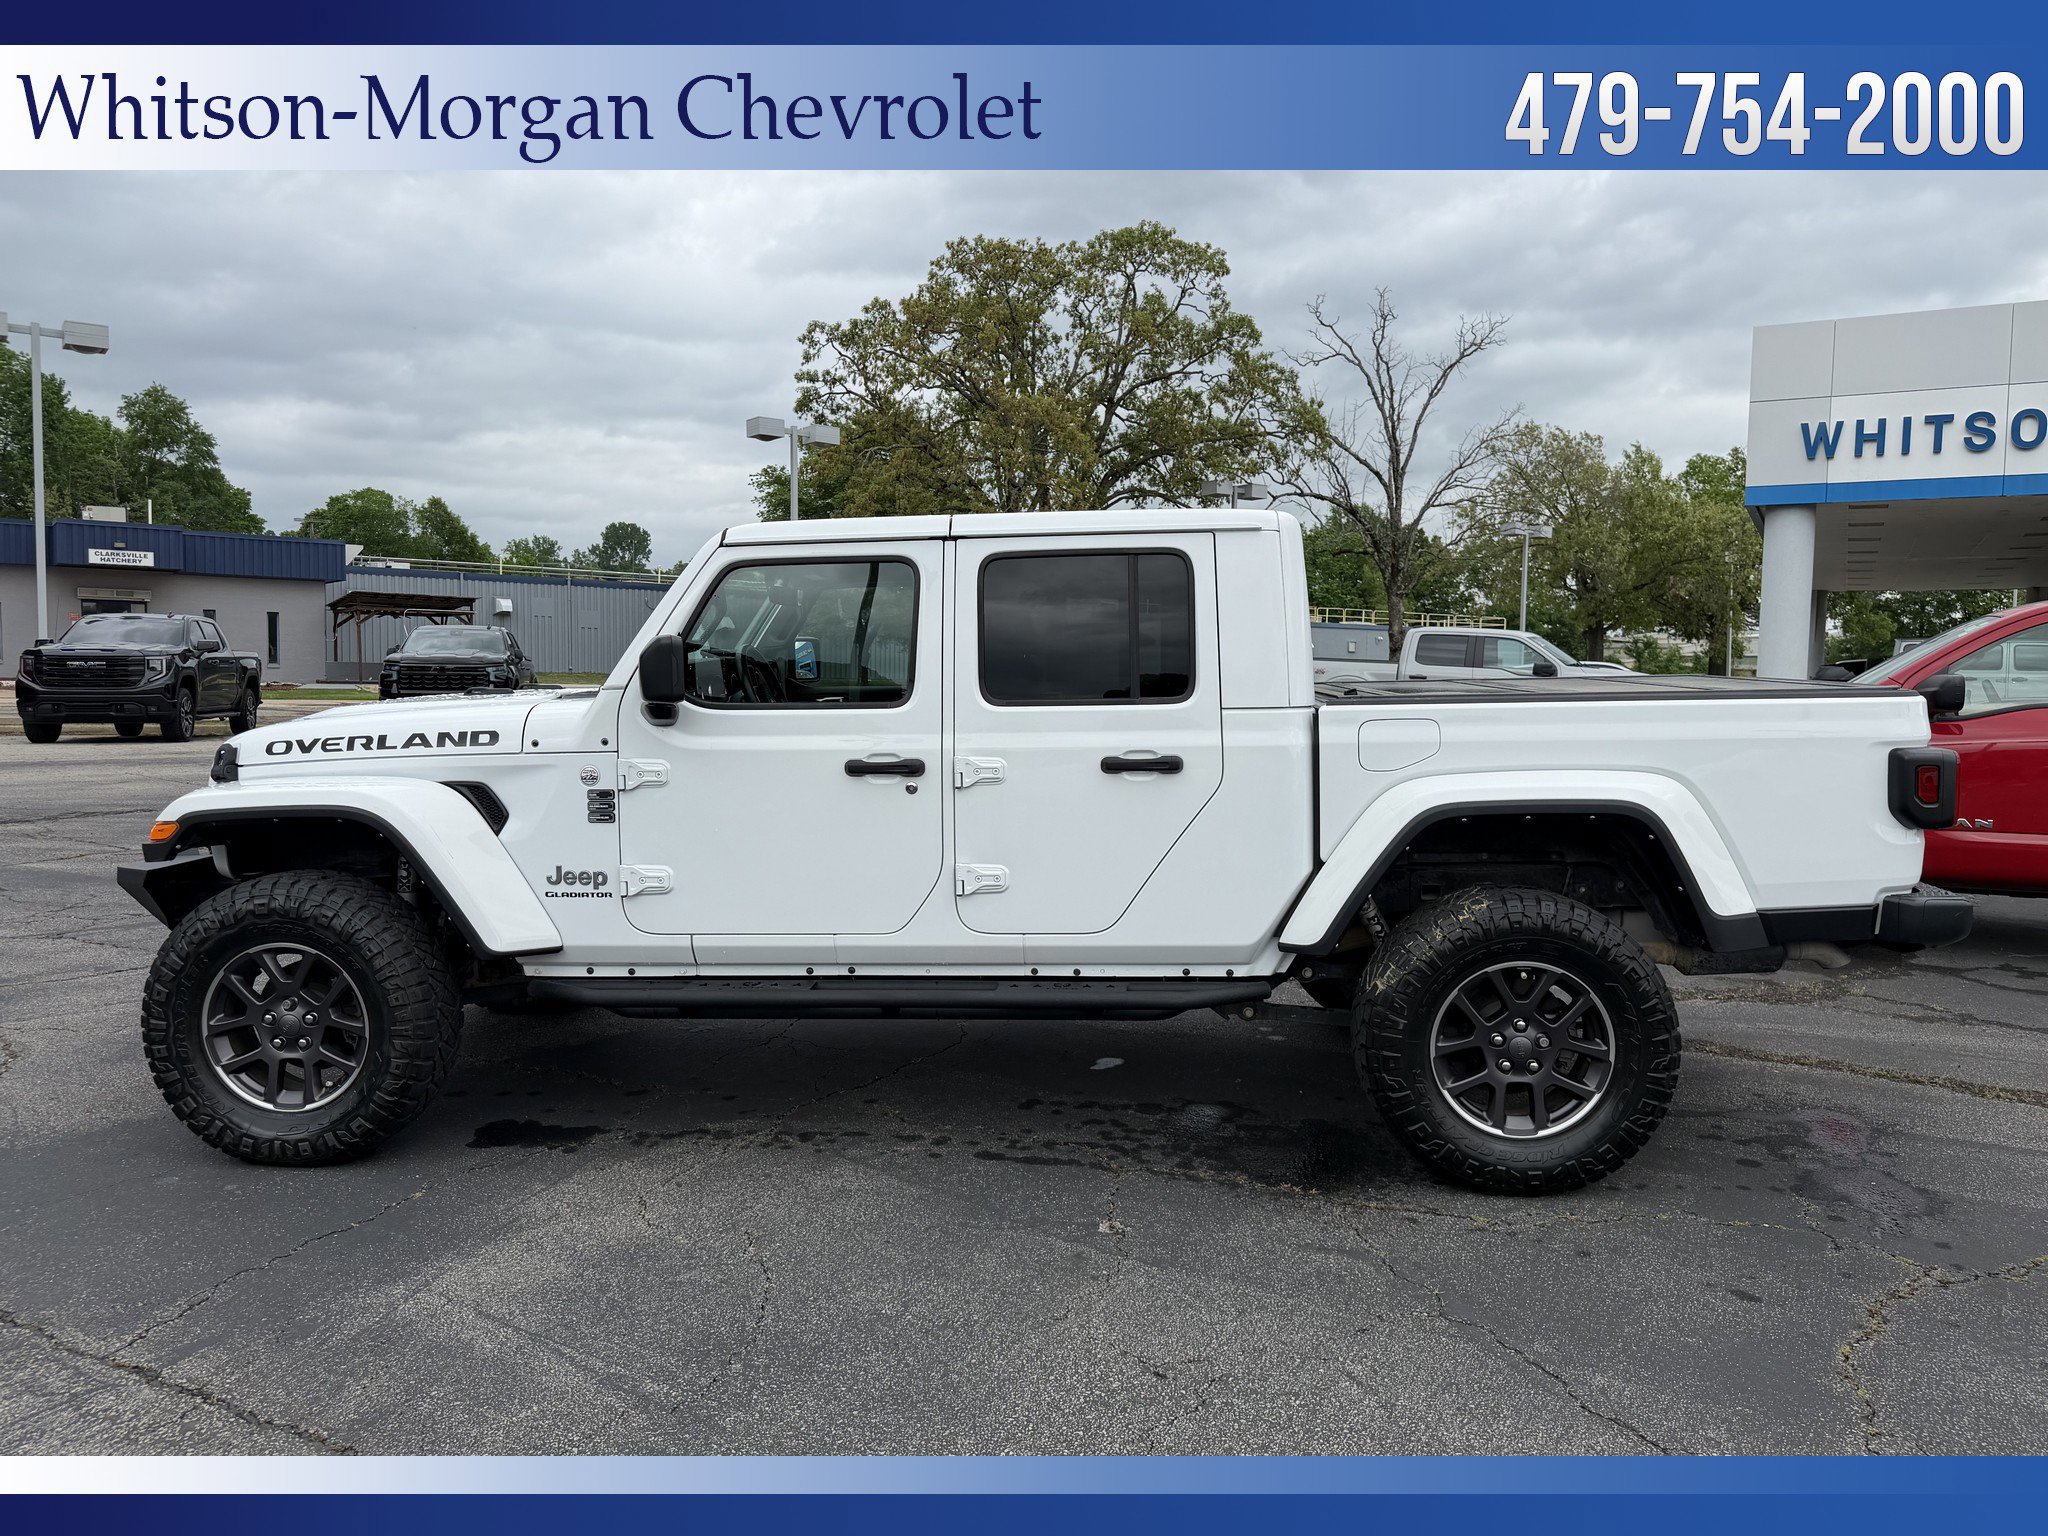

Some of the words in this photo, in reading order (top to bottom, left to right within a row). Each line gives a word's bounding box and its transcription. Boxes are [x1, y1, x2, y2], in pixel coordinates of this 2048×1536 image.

[94, 551, 149, 559] CLARKSVILLE
[66, 661, 107, 669] GMC
[265, 730, 500, 756] OVERLAND
[546, 865, 609, 890] Jeep
